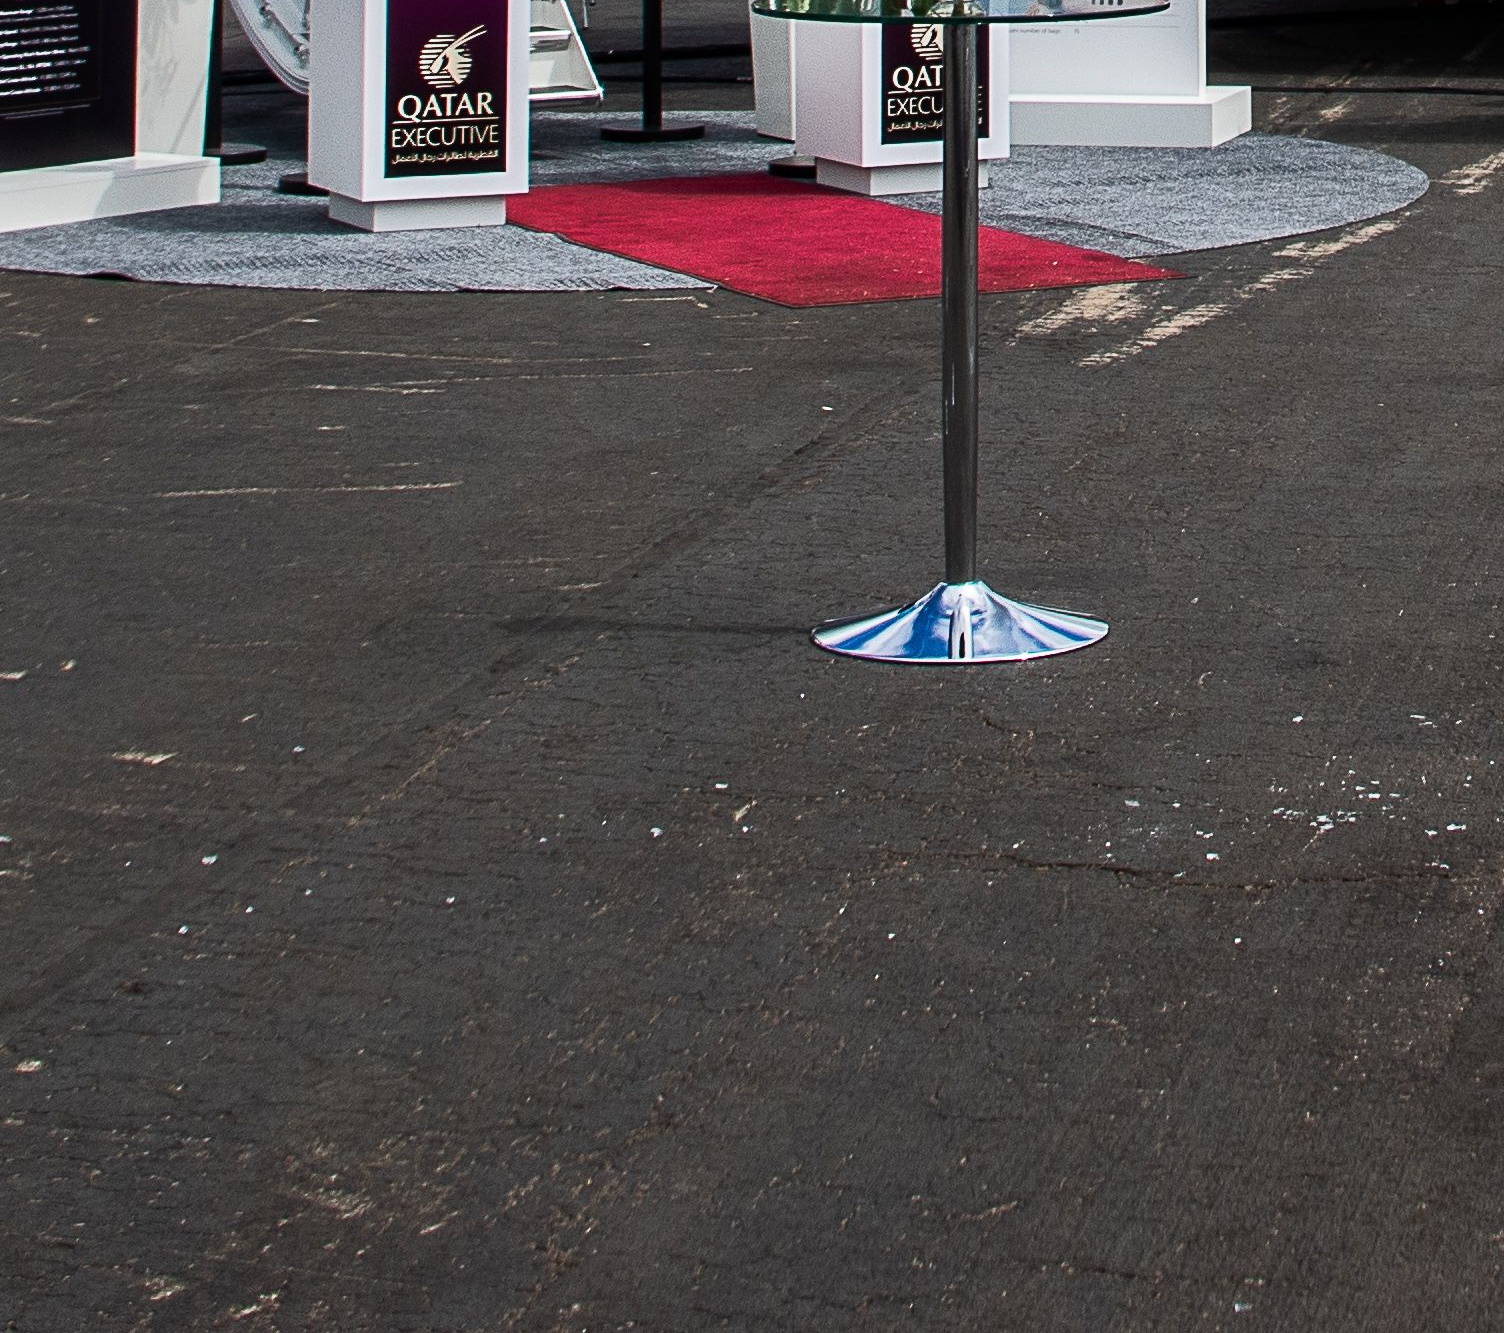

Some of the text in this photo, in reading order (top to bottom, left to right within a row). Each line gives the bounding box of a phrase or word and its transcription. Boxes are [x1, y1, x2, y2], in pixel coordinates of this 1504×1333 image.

[892, 65, 943, 93] QAT
[398, 92, 494, 123] QATAR
[887, 96, 944, 117] EXECU
[392, 124, 499, 148] EXECUTIVE
